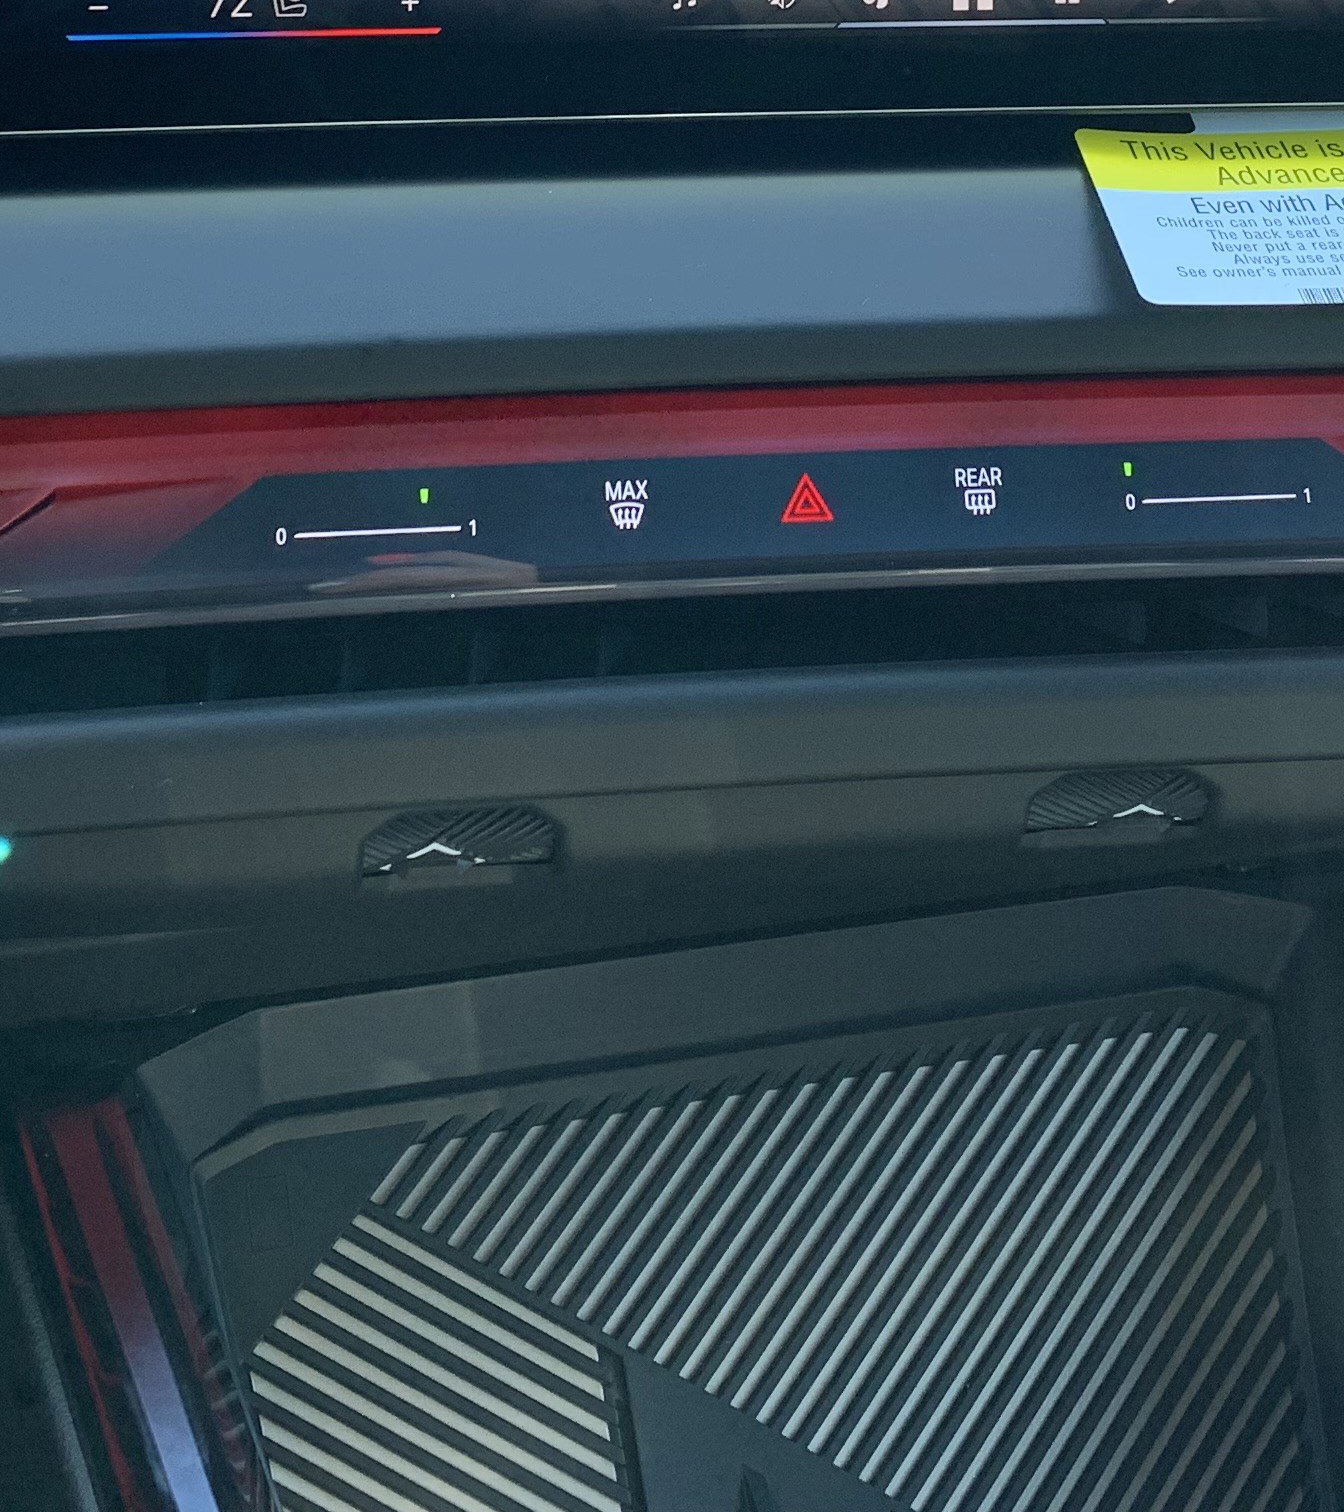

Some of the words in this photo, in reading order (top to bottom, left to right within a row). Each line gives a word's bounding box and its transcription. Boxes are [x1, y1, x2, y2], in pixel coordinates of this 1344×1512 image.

[1120, 140, 1188, 161] This
[1195, 139, 1308, 161] Vehicle
[1315, 138, 1344, 157] is
[1190, 196, 1254, 215] Even
[1259, 193, 1317, 213] with
[1156, 216, 1224, 228] Children
[1230, 218, 1257, 228] can
[1263, 216, 1283, 227] be
[1288, 214, 1331, 226] killed
[1207, 229, 1237, 240] The
[1242, 228, 1282, 240] back
[1288, 227, 1320, 239] seat
[1325, 227, 1339, 238] is
[1211, 241, 1258, 253] Never
[1265, 240, 1292, 254] put
[1297, 241, 1306, 251] a
[1234, 253, 1291, 266] Always
[1296, 254, 1325, 265] use
[1176, 266, 1207, 278] See
[1212, 265, 1277, 278] owner's
[1282, 264, 1341, 277] manual
[955, 467, 1003, 488] REAR
[605, 479, 649, 501] MAX
[1303, 486, 1312, 504] 1
[1125, 493, 1136, 511] 0
[275, 527, 288, 546] 0
[468, 518, 478, 537] 1
